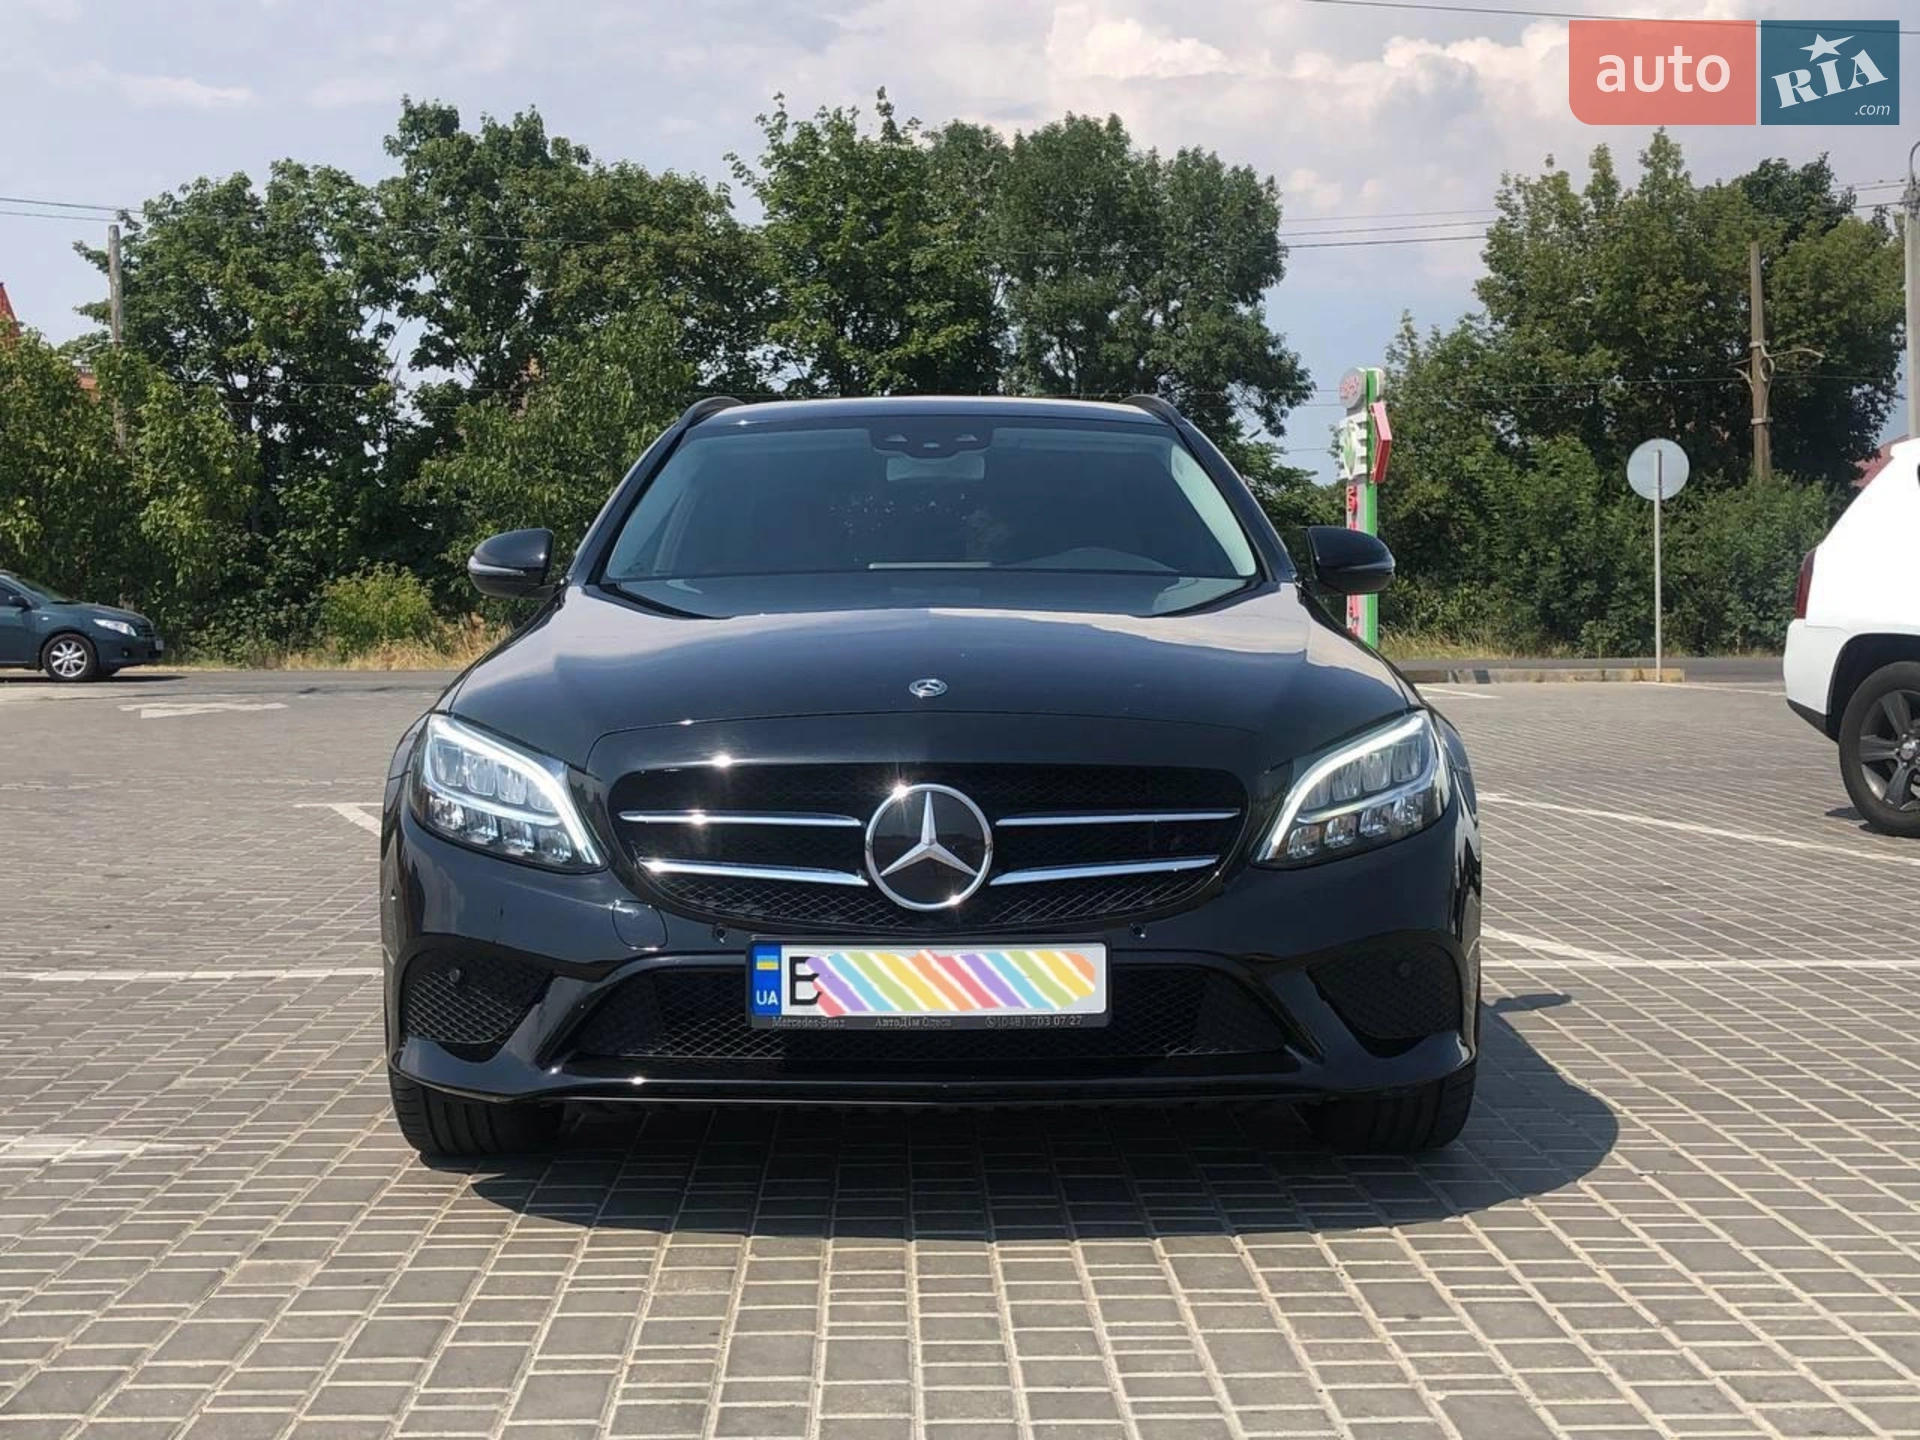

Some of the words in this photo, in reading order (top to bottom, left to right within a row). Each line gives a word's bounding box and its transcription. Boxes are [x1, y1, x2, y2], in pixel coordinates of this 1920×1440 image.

[756, 990, 779, 1006] UA
[771, 1016, 846, 1029] Mercedes-Benz
[1031, 1016, 1051, 1027] 703
[1053, 1015, 1065, 1026] 07
[1069, 1015, 1083, 1026] 27
